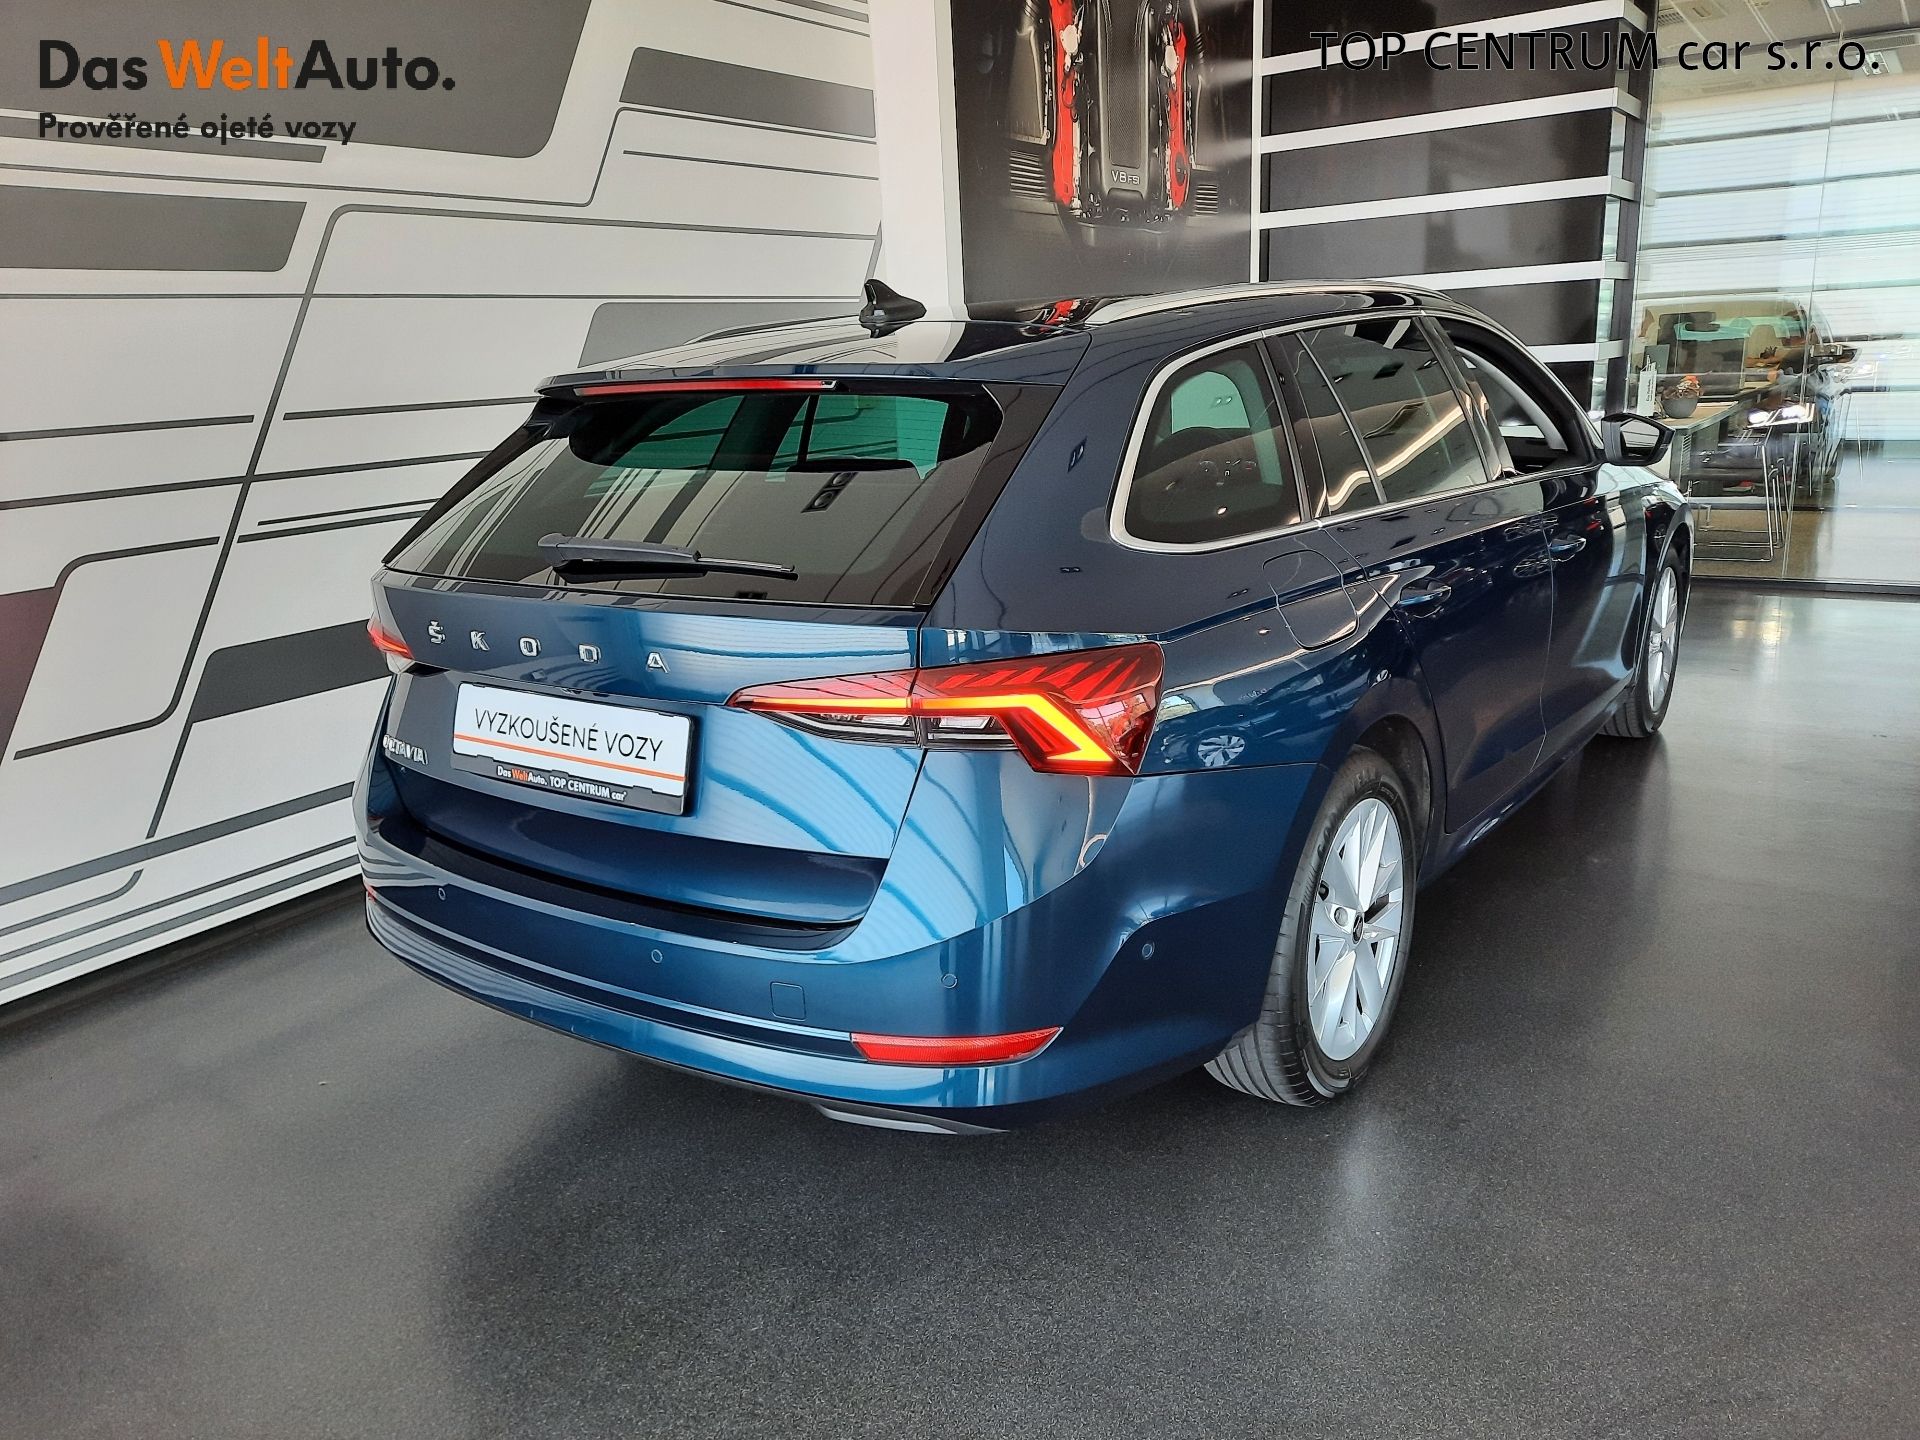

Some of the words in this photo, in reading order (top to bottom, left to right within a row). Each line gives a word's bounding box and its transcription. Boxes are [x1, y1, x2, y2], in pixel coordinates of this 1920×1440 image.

[428, 620, 670, 674] ŠKODA
[383, 734, 428, 765] OCTAVIA
[475, 707, 598, 751] VYZKOUŠENÉ
[604, 731, 663, 762] VOZY
[497, 765, 511, 778] Das
[550, 775, 566, 789] TOP
[567, 780, 610, 799] CENTRUM
